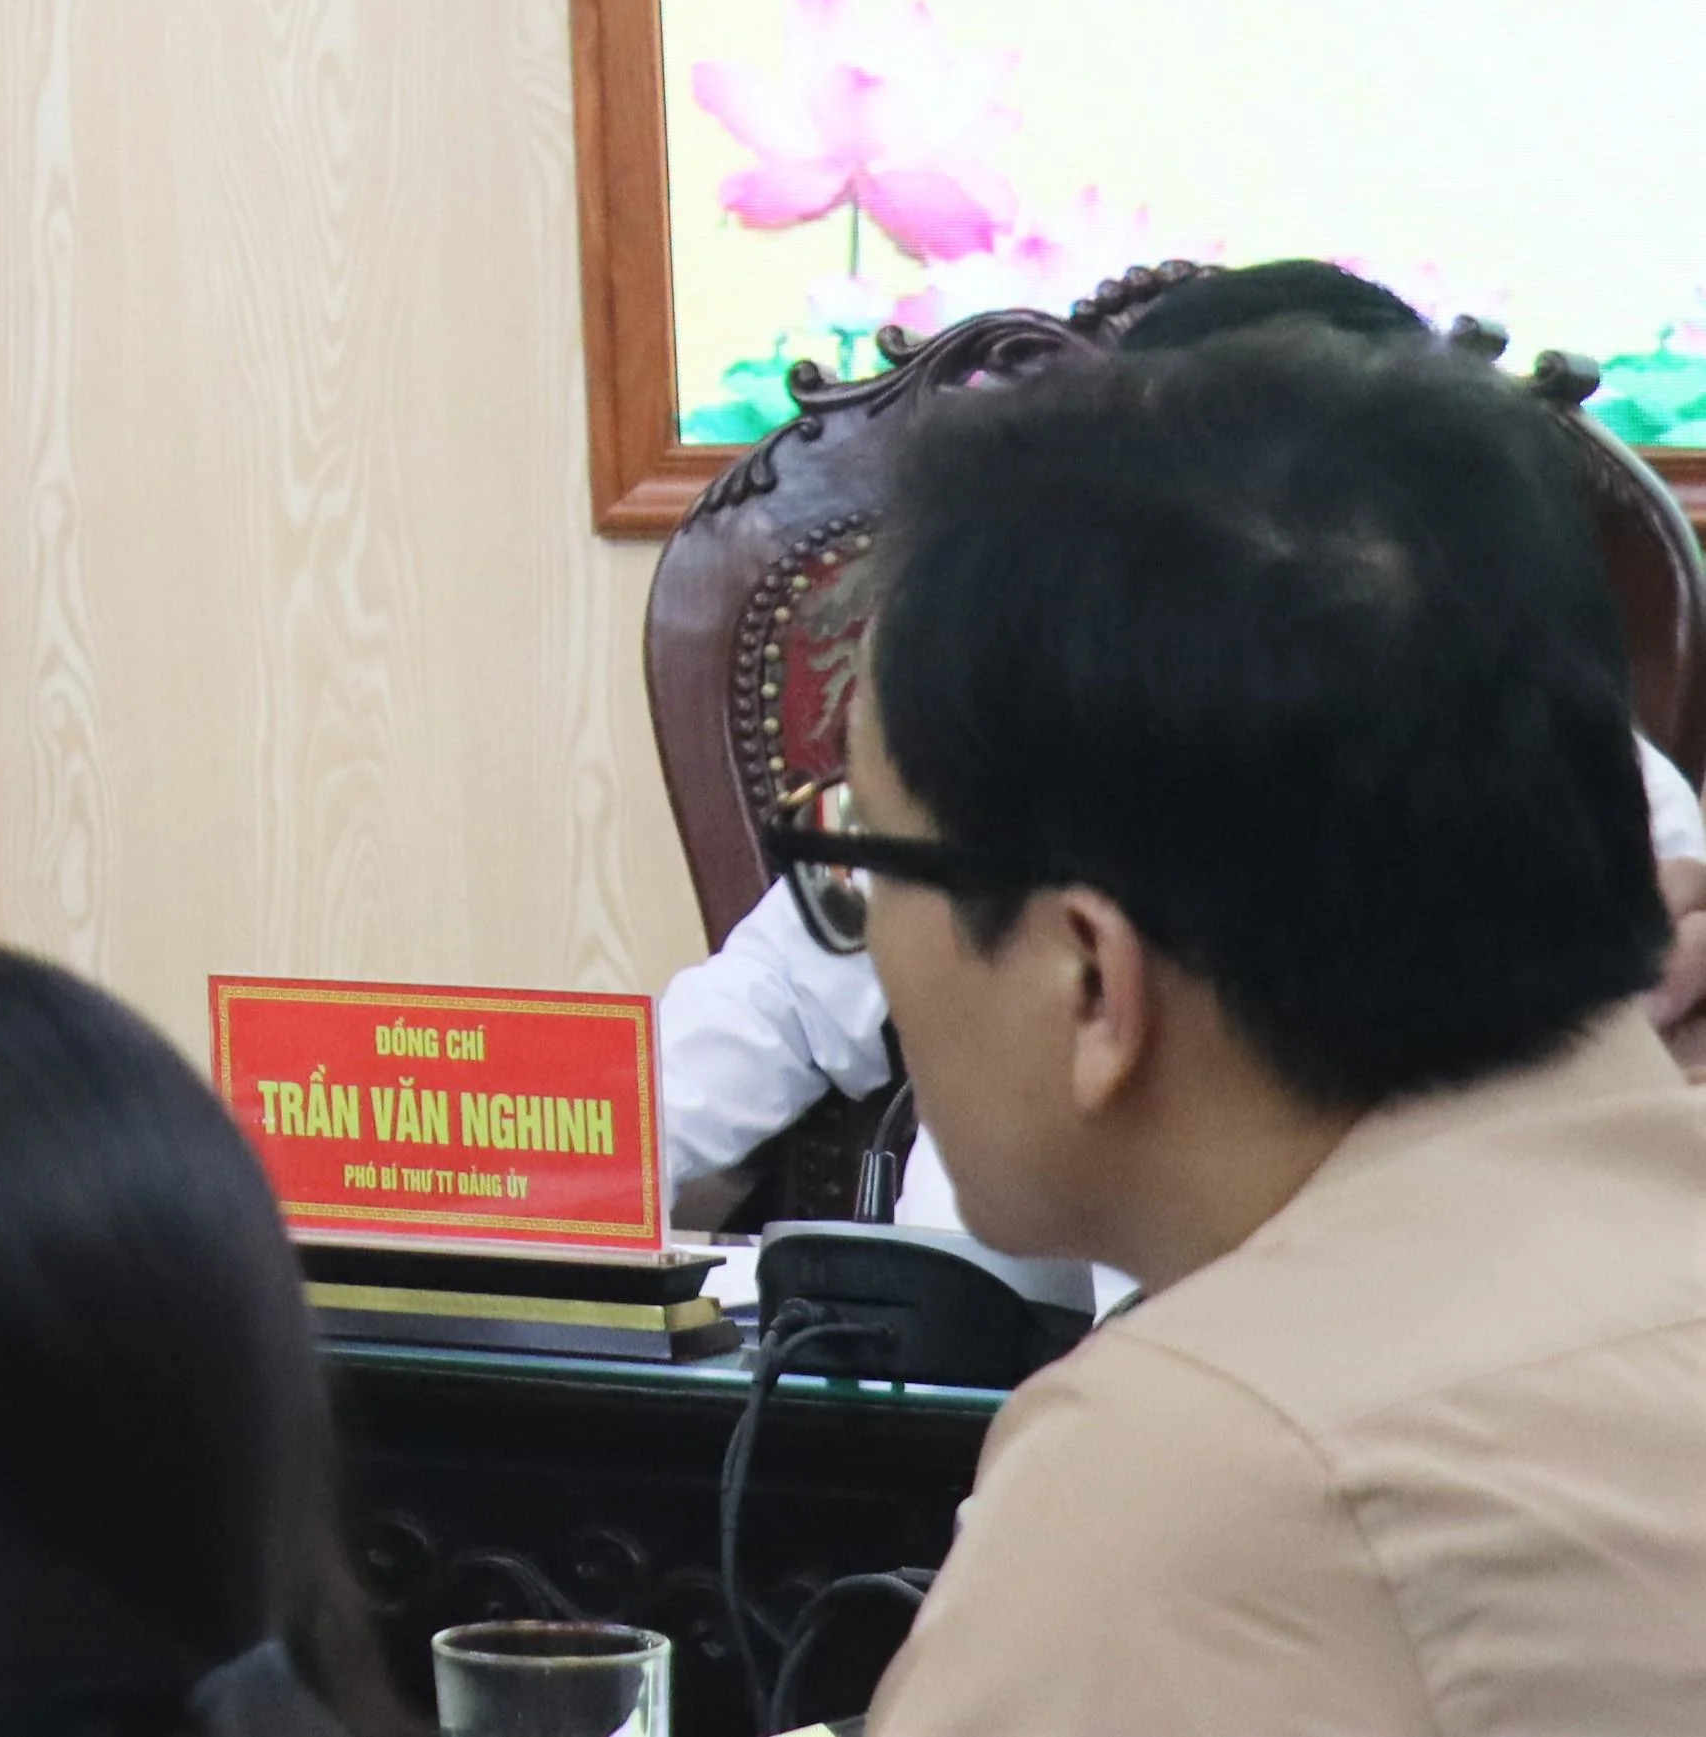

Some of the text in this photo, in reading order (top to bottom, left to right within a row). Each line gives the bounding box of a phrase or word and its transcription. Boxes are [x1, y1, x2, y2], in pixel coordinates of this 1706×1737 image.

[375, 1016, 486, 1062] ĐỒNG CHÍ
[256, 1063, 615, 1156] TRẦN VĂN NGHINH
[344, 1161, 528, 1199] PHÓ BÍ THƯ TT ĐẢNG ỦY
